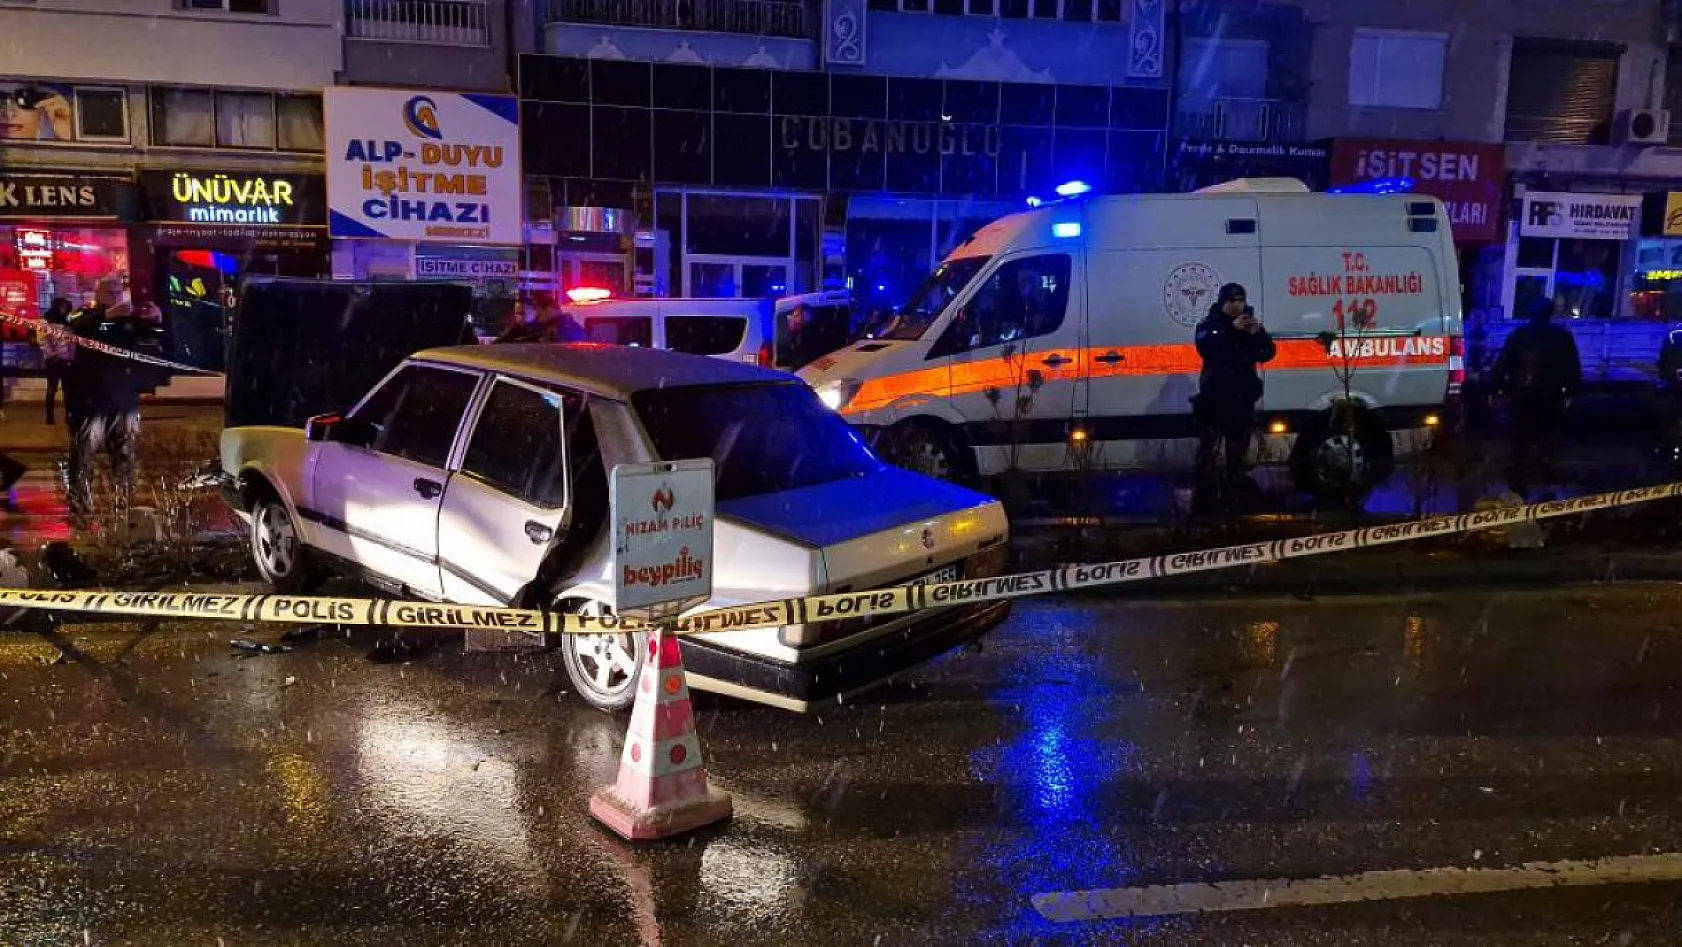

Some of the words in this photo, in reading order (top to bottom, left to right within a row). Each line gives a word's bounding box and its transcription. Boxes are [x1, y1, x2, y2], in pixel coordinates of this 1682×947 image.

[421, 142, 503, 168] DUYU
[24, 185, 95, 207] LENS
[1329, 337, 1445, 358] AMBULANS
